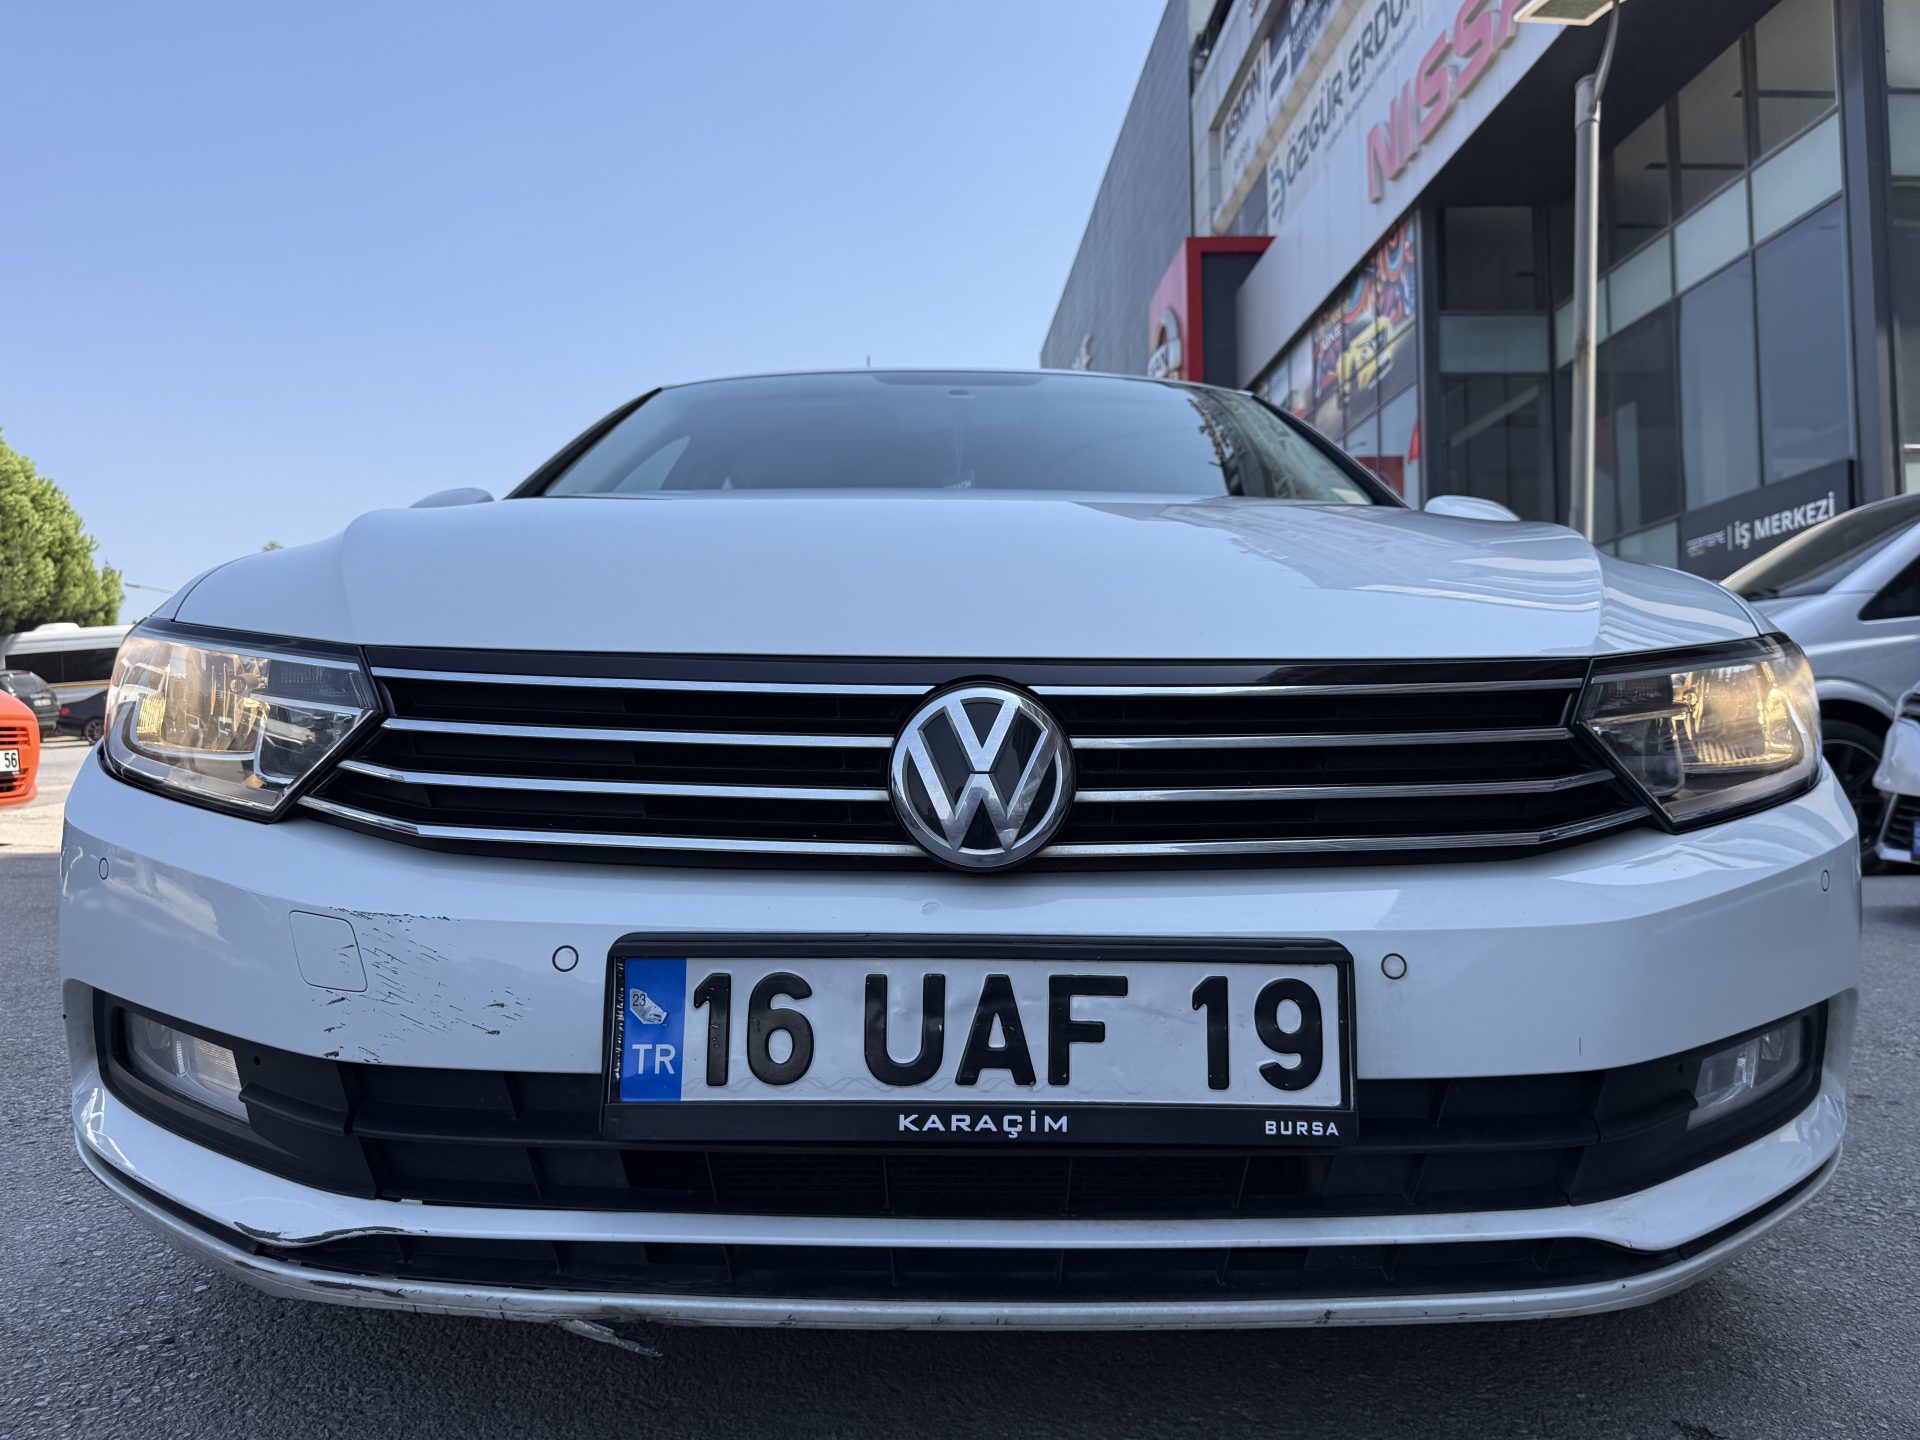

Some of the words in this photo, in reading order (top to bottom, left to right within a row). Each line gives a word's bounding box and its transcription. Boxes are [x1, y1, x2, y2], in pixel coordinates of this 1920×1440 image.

[1286, 69, 1343, 186] ÖZGÜR
[1734, 520, 1751, 550] İŞ
[1753, 490, 1835, 541] MERKEZİ
[4, 752, 18, 768] 56
[632, 993, 647, 1007] 23
[693, 972, 815, 1087] 16
[865, 973, 1129, 1087] UAF
[1192, 975, 1324, 1092] 19
[632, 1043, 676, 1075] TR
[898, 1109, 1068, 1139] KARAÇİM
[1265, 1119, 1340, 1137] BURSA
